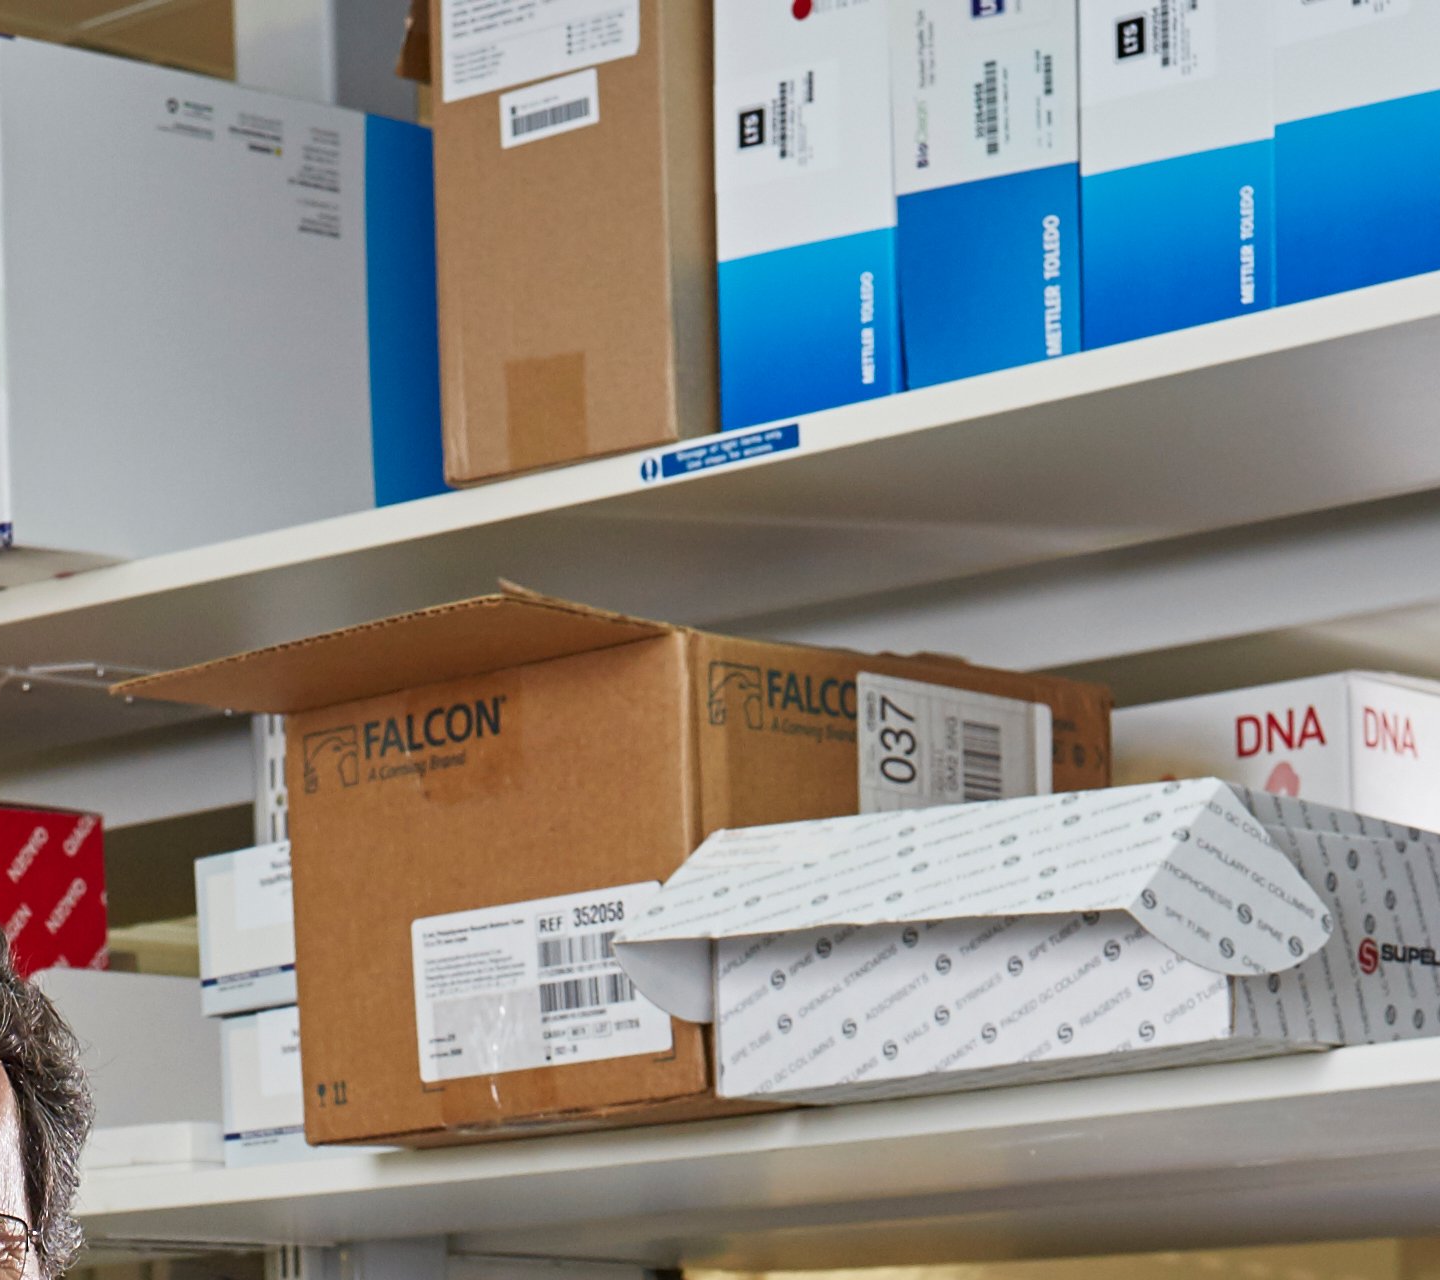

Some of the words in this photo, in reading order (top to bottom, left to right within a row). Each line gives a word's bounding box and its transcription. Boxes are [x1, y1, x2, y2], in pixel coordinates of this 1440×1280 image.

[1240, 185, 1255, 240] TOLEDO
[1043, 214, 1060, 281] TOLEDO
[1240, 246, 1255, 304] METTLER
[861, 272, 874, 324] TOLEDO
[1045, 287, 1063, 357] METTLER
[861, 329, 875, 384] METTLER
[880, 695, 917, 785] 037
[1235, 704, 1326, 759] DNA
[1364, 705, 1418, 760] DNA
[539, 914, 564, 933] REF
[573, 900, 625, 928] 352058
